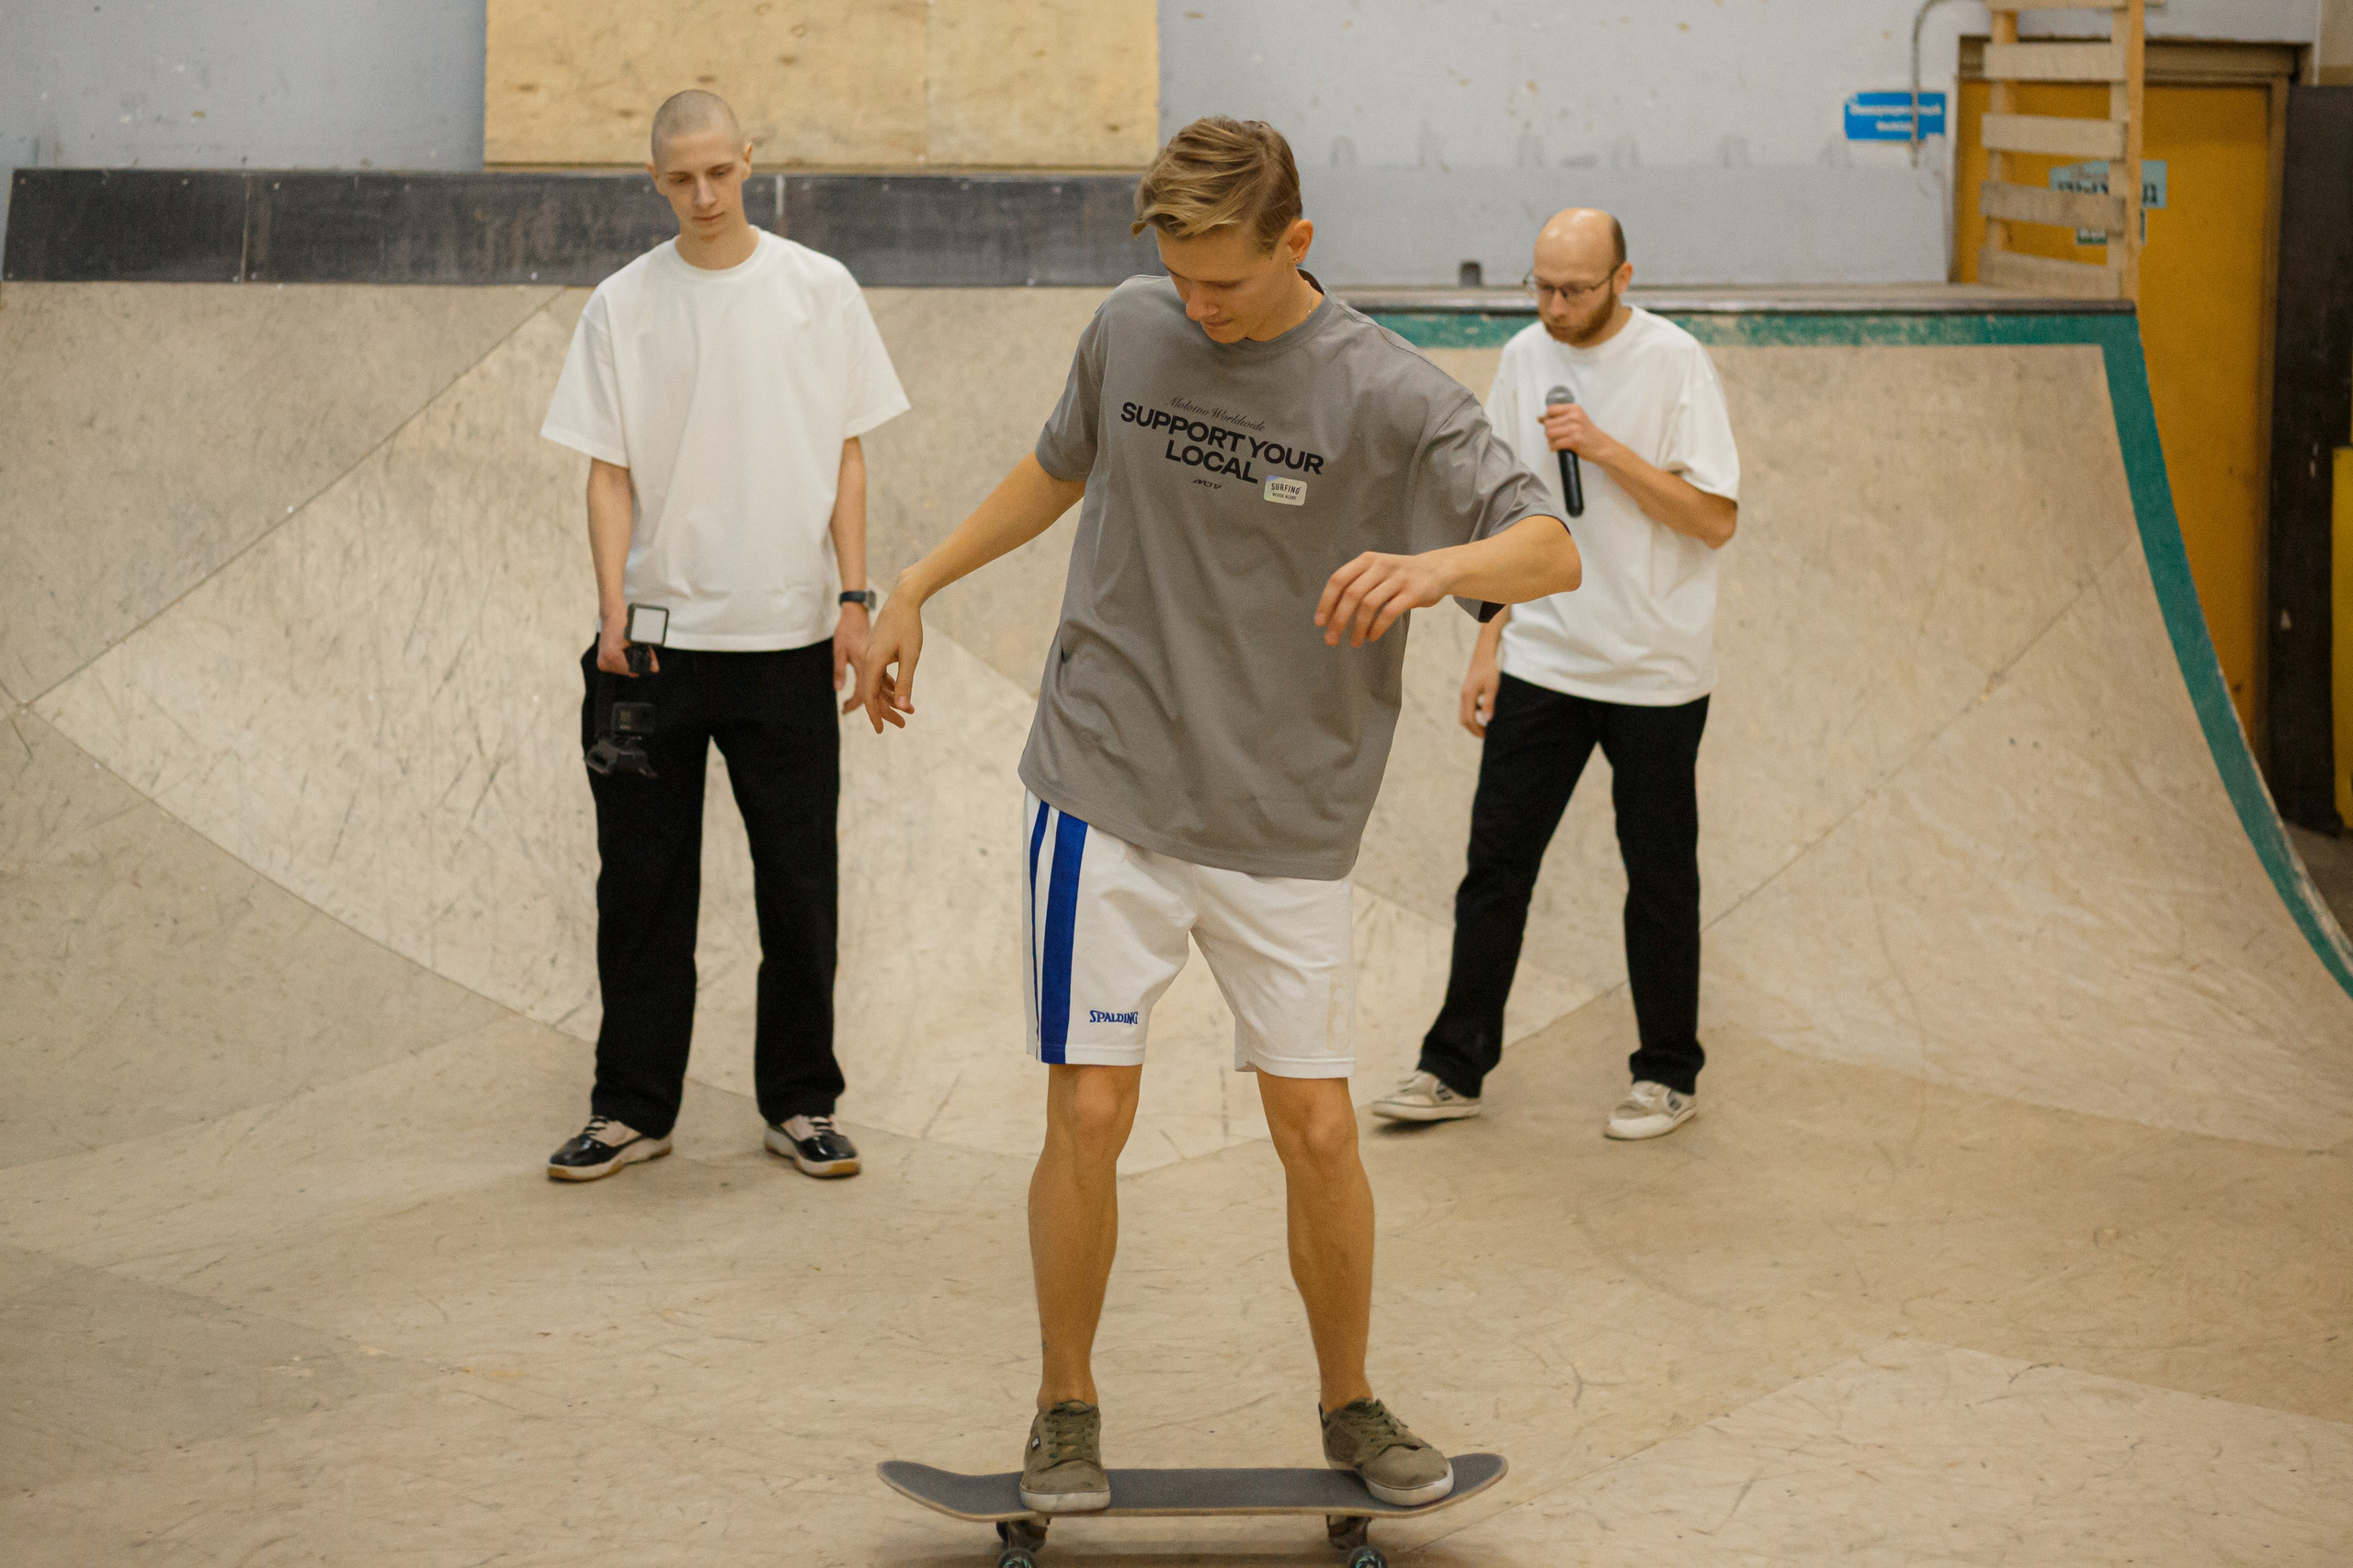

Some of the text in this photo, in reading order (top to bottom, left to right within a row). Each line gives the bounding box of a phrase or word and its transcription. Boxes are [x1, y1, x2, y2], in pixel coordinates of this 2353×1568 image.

[1211, 407, 1266, 431] Worldwide
[1120, 402, 1324, 475] SUPPORT YOUR
[1165, 439, 1258, 484] LOCAL
[1271, 483, 1301, 494] SURFING
[1089, 1010, 1139, 1025] SPALDING
